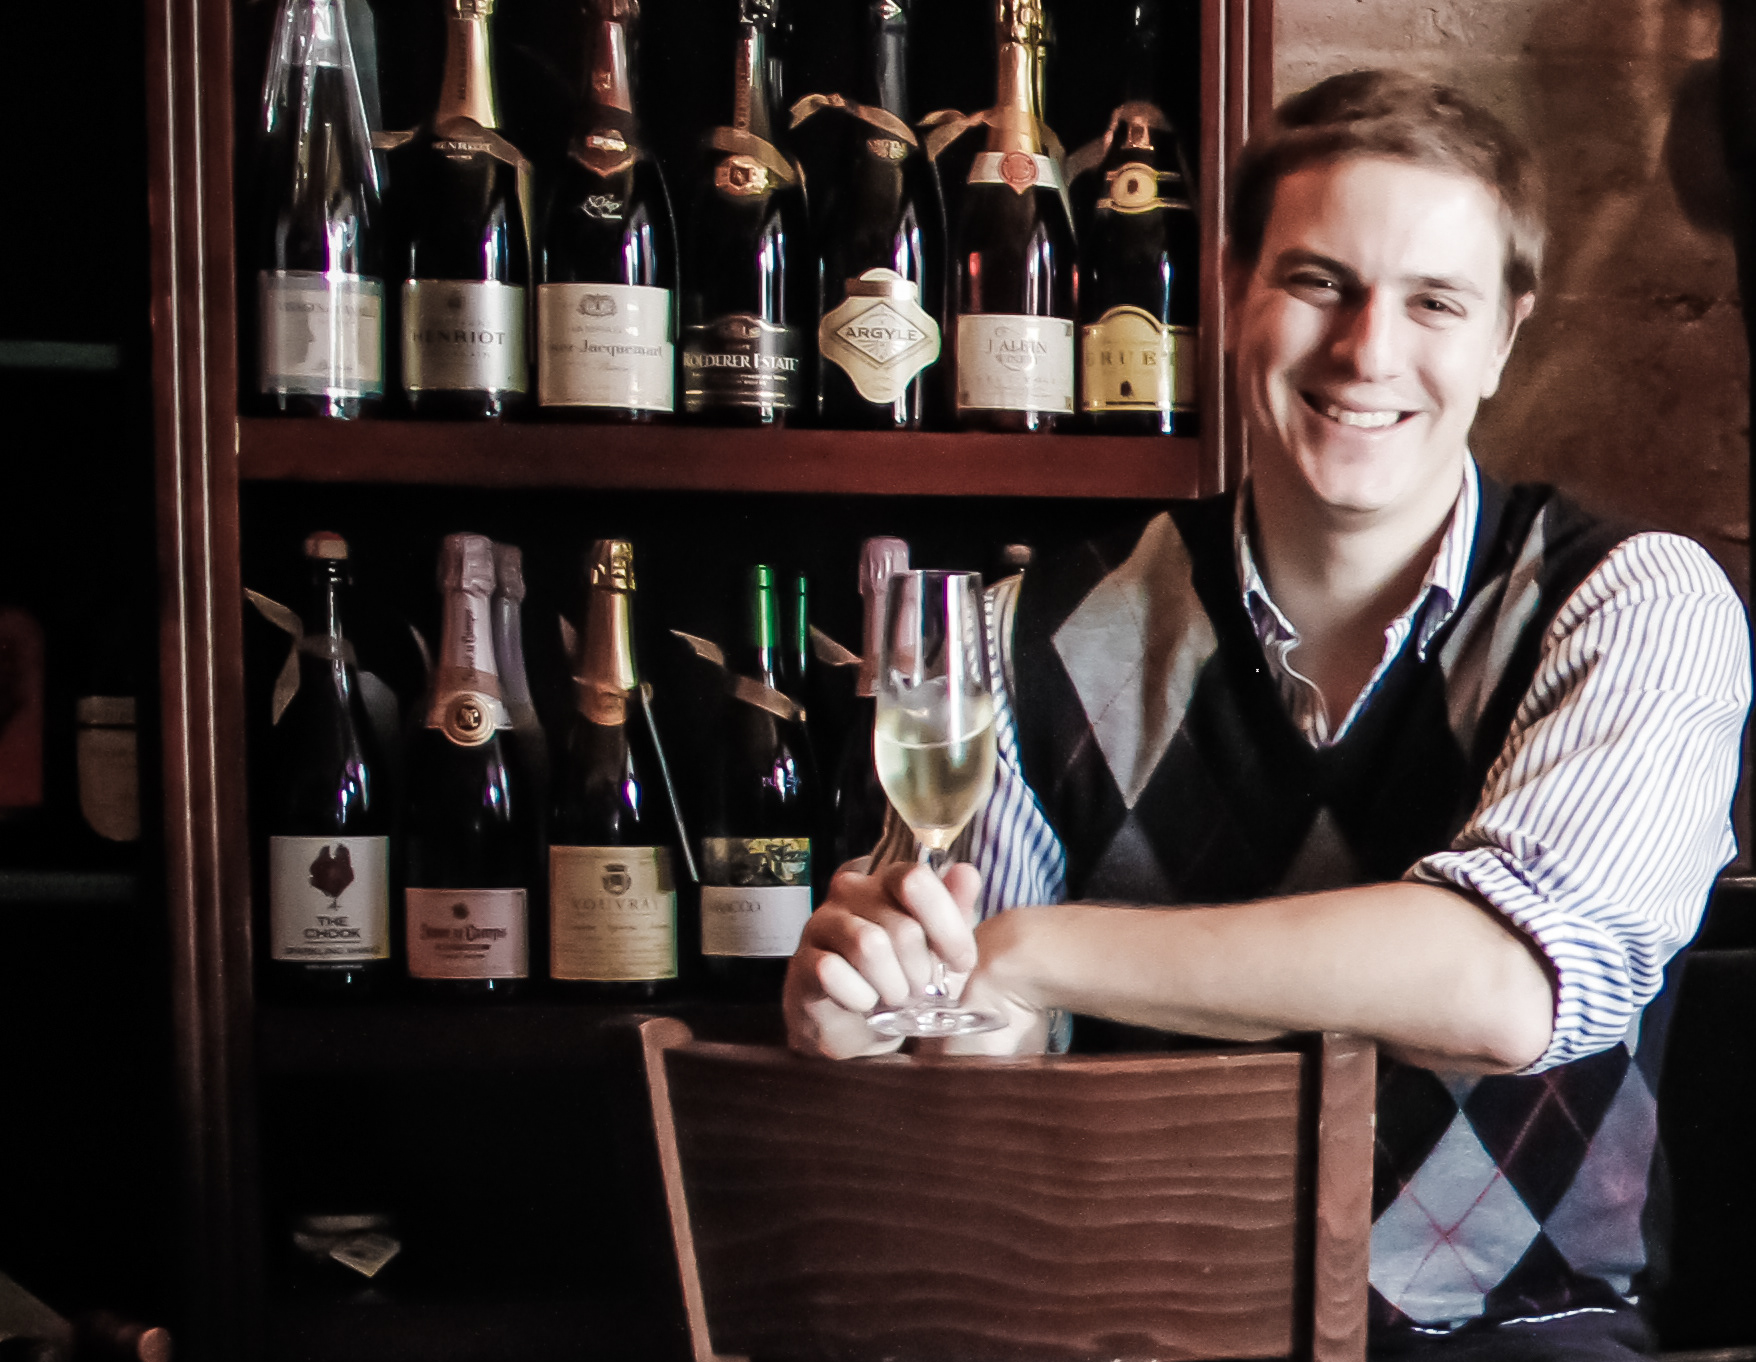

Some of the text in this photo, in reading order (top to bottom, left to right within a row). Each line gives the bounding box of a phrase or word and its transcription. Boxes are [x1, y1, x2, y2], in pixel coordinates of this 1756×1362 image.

[413, 329, 506, 345] HENRIOT
[845, 327, 918, 341] ARGYLE
[683, 352, 752, 368] ROEDERER
[316, 916, 348, 926] THE
[303, 928, 361, 939] CHOOK
